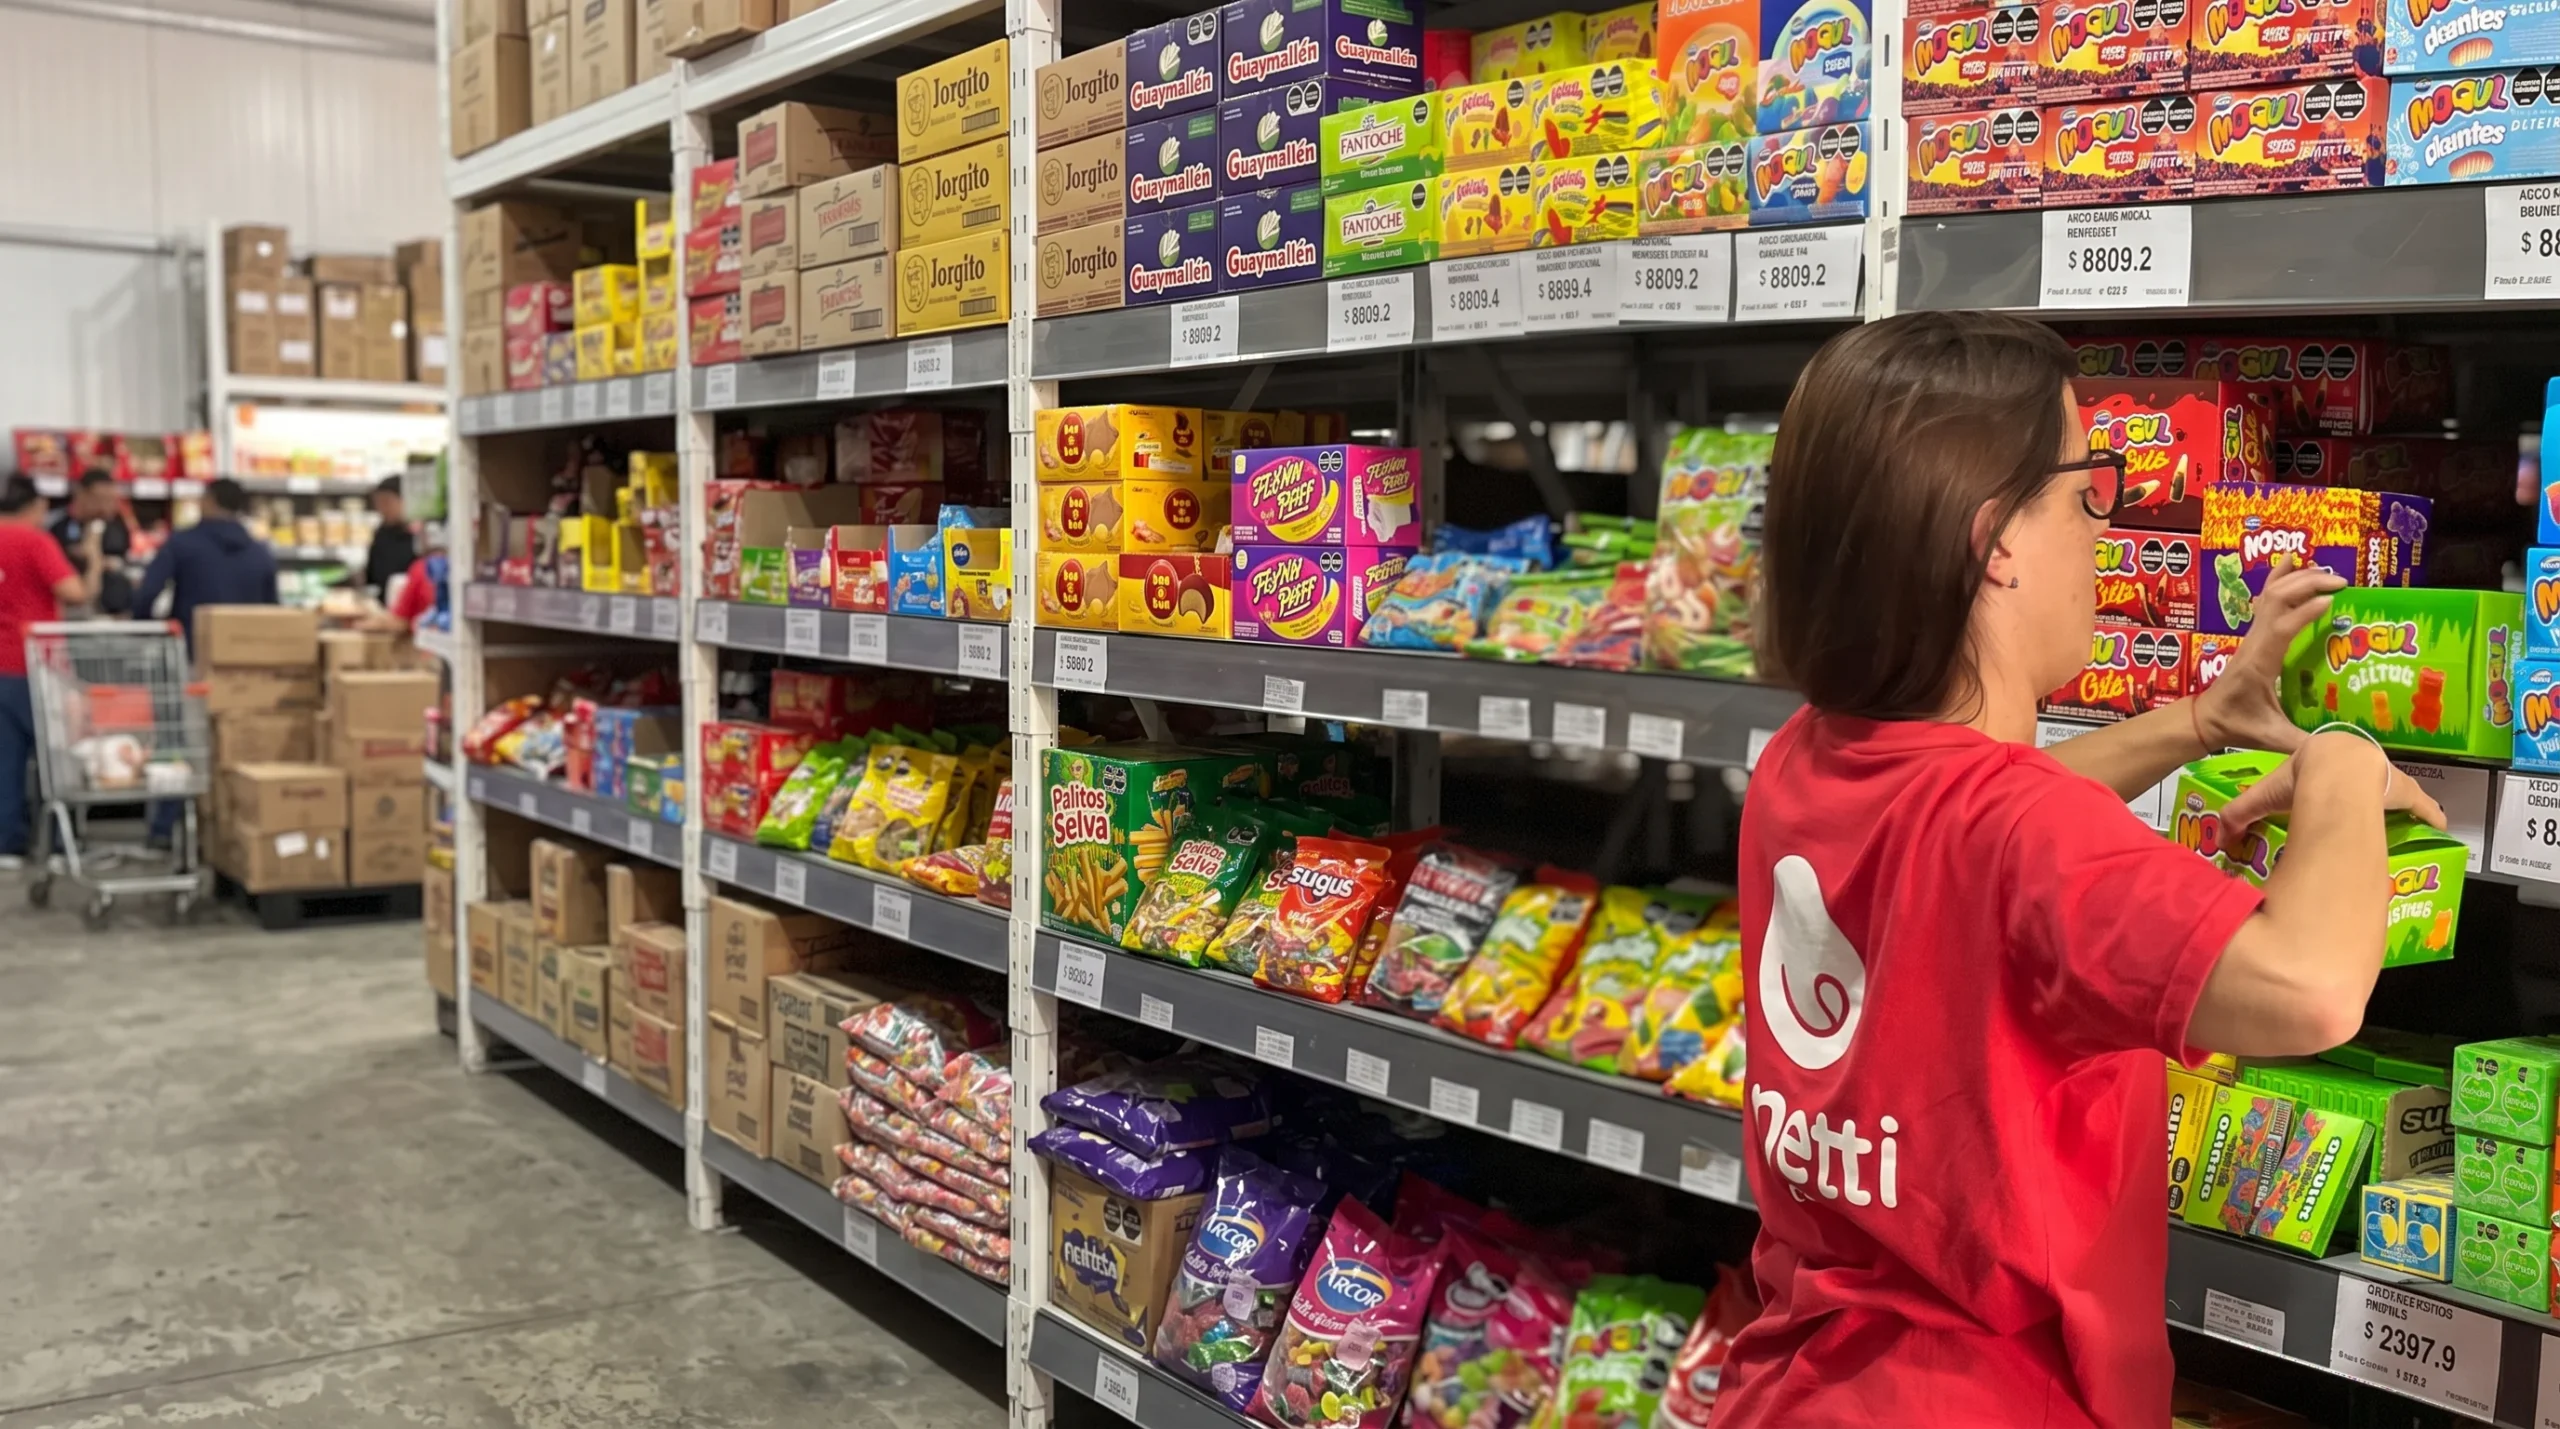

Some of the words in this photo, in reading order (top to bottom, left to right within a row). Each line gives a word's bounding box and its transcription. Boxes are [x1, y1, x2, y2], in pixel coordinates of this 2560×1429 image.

[1228, 37, 1319, 83] Guaymallén
[1335, 36, 1417, 68] Guaymallén
[933, 67, 989, 108] Jorgito
[1065, 69, 1119, 104] Jorgito
[1131, 68, 1212, 110] Guaymallén
[1340, 127, 1403, 155] FANTOCHE
[1065, 159, 1118, 192] Jorgito
[1227, 138, 1316, 181] Guaymallén
[935, 162, 989, 200] Jorgito
[1130, 163, 1212, 202] Guaymallén
[1343, 212, 1403, 237] FANTOCHE
[1227, 238, 1316, 277] Guaymallén
[2068, 251, 2077, 271] $
[2083, 246, 2152, 273] 8809.2
[2521, 231, 2532, 255] $
[931, 254, 985, 292] Jorgito
[1065, 246, 1117, 279] Jorgito
[1130, 257, 1211, 294] Guaymallén
[1635, 271, 1641, 287] $
[1645, 268, 1698, 290] 8809.2
[1759, 270, 1766, 287] $
[1771, 264, 1826, 288] 8809.2
[1450, 293, 1456, 309] $
[1539, 283, 1545, 299] $
[1548, 278, 1592, 300] 8899.4
[1344, 310, 1350, 325] $
[2090, 415, 2171, 450] MOGUL
[2328, 624, 2417, 672] MOGUL
[1052, 783, 1105, 811] Palitos
[1054, 810, 1108, 844] Selva
[2527, 818, 2536, 840] $
[1171, 853, 1219, 876] Selva
[1288, 866, 1354, 897] sugus
[1752, 1083, 1899, 1209] netti
[1207, 1212, 1256, 1254] ARCOR
[1329, 1267, 1383, 1308] ARCOR
[2379, 1325, 2456, 1372] 2397.9
